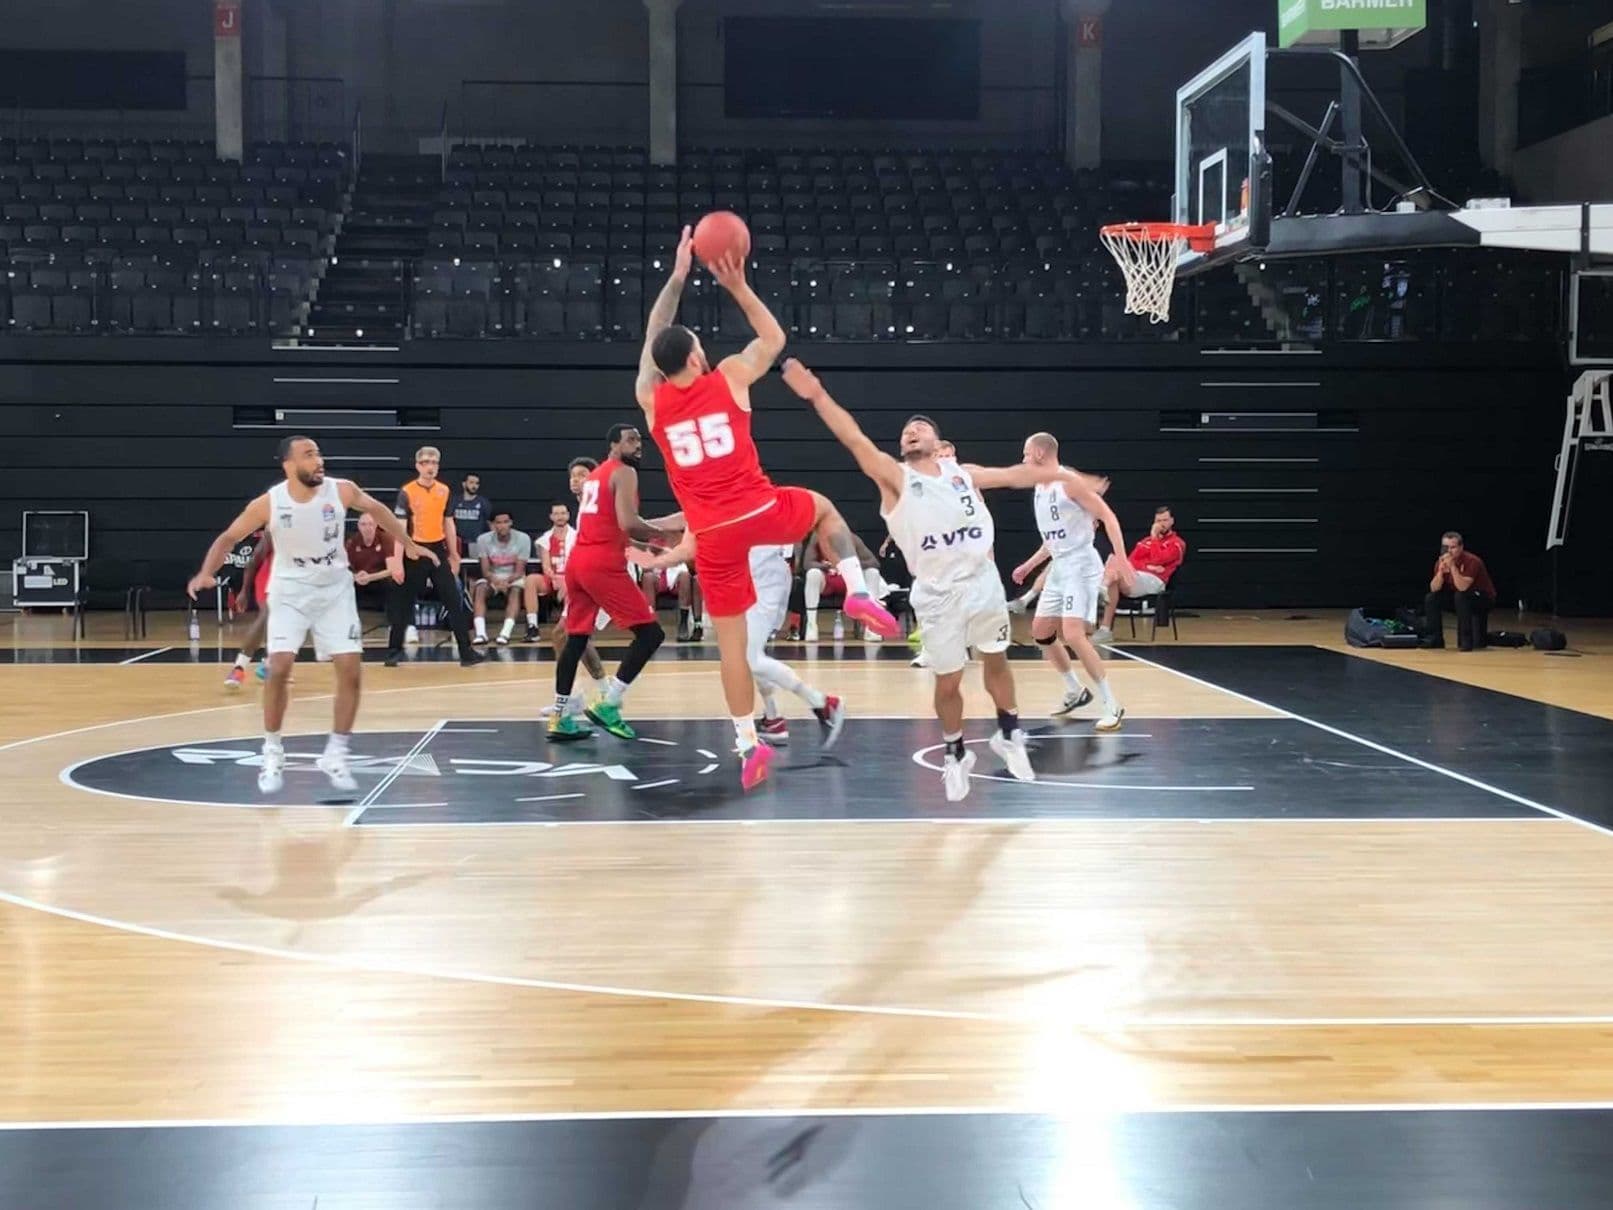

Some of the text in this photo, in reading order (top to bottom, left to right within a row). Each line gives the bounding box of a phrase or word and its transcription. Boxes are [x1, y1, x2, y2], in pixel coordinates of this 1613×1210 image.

[222, 11, 233, 28] J
[1083, 24, 1095, 40] K
[664, 412, 735, 468] 55
[960, 496, 975, 517] 3
[1050, 505, 1060, 521] 8
[942, 527, 982, 546] VTG
[1043, 529, 1066, 541] VTG
[1065, 595, 1074, 611] 8
[997, 624, 1008, 642] 3
